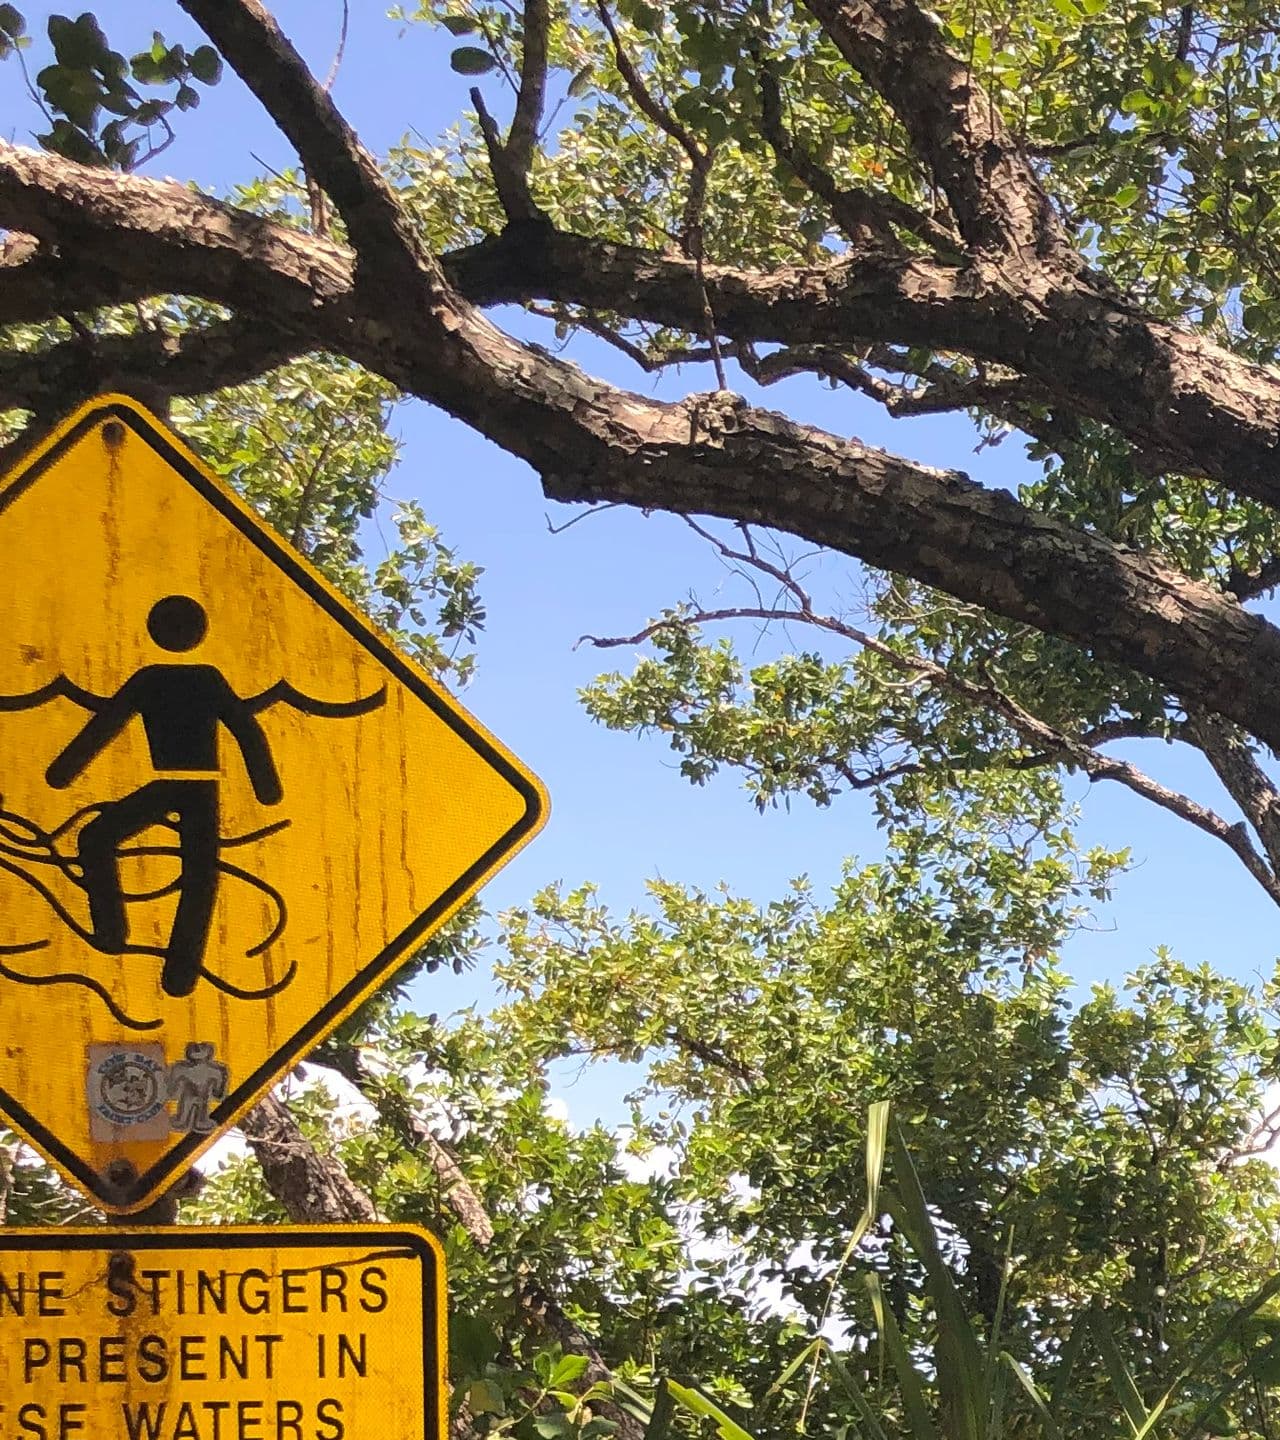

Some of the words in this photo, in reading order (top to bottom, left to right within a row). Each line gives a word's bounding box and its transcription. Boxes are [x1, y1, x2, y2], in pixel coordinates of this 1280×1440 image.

[107, 1267, 388, 1317] STINGERS
[24, 1334, 283, 1383] PRESENT
[318, 1333, 367, 1378] IN
